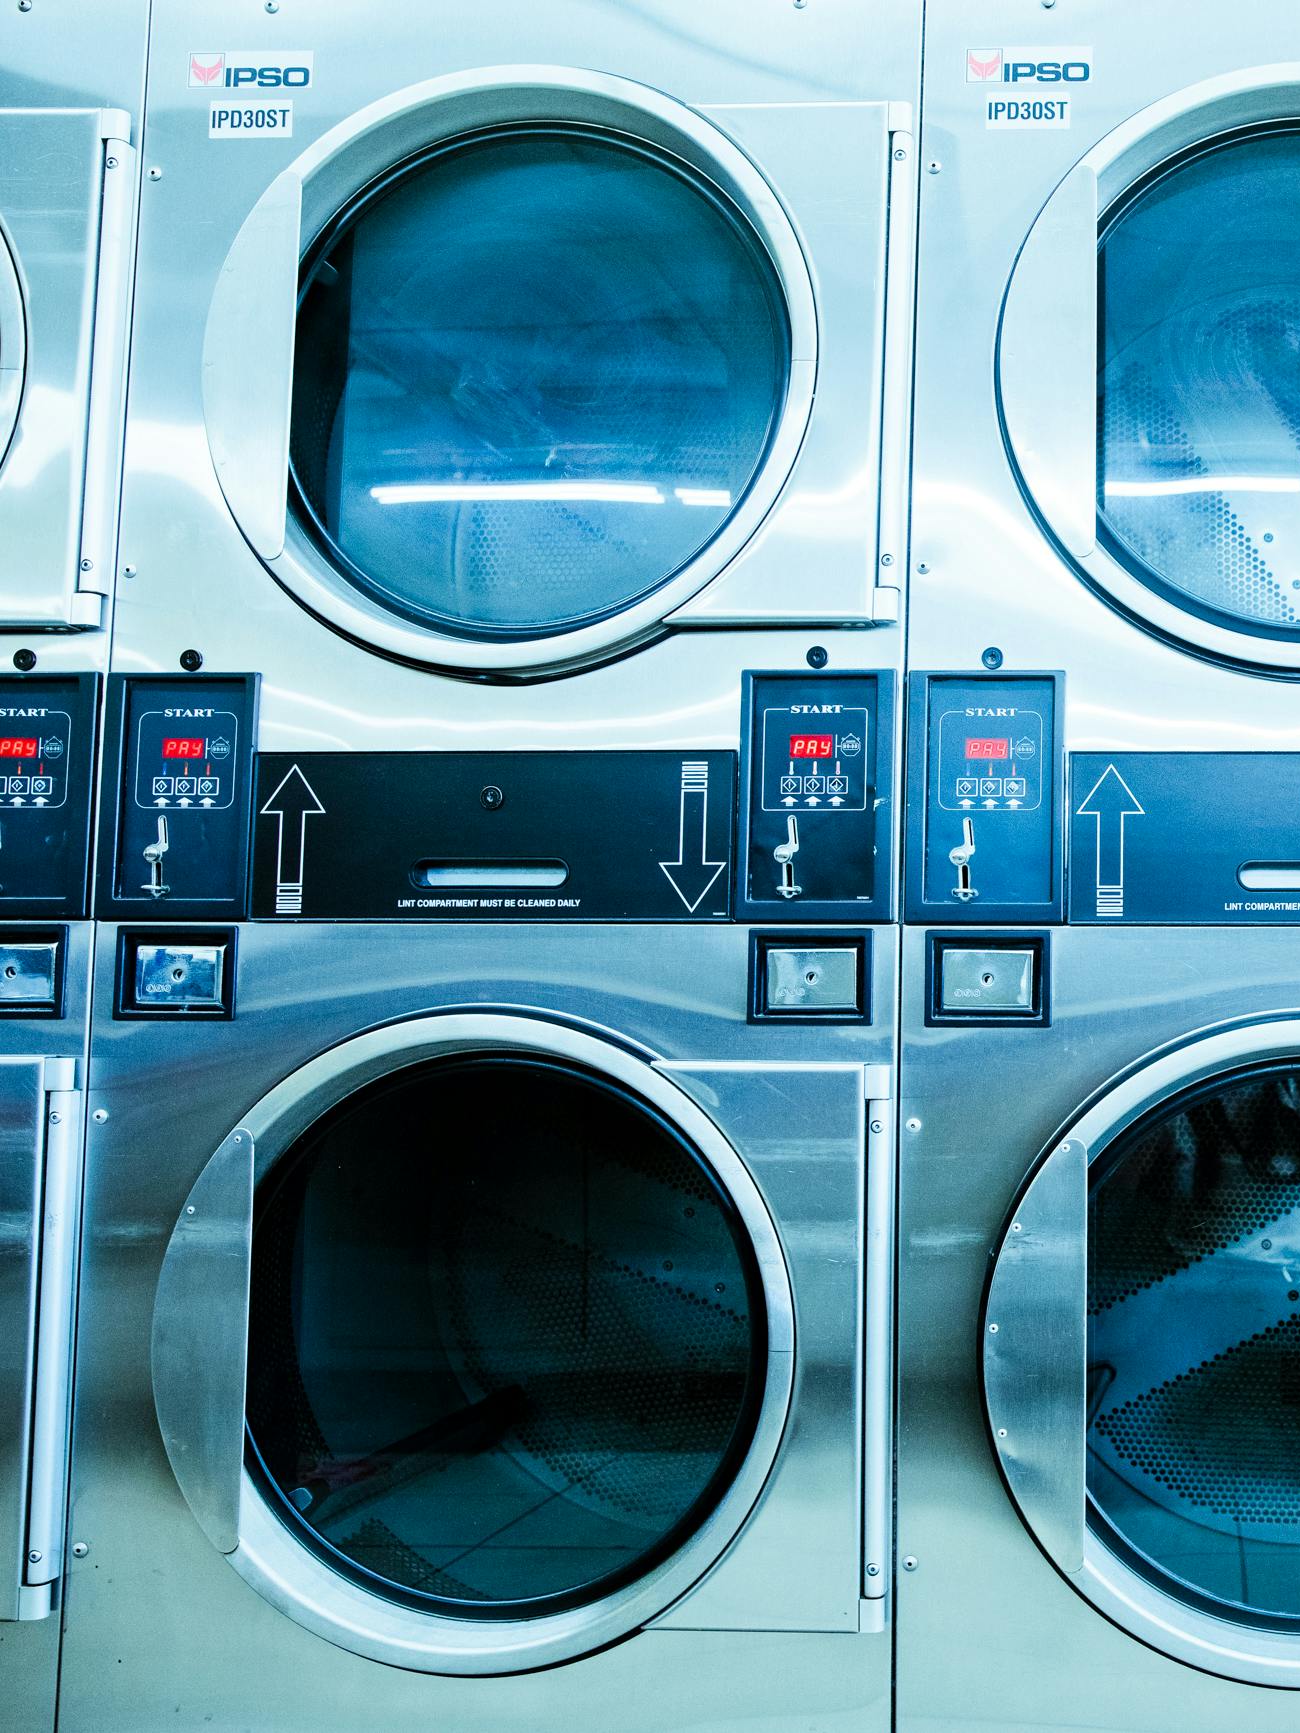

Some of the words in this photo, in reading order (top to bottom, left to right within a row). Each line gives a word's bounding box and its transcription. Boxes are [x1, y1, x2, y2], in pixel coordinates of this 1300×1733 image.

[225, 67, 310, 87] IPSO
[1004, 62, 1090, 82] IPSO
[988, 101, 1068, 120] IPD30ST
[211, 109, 290, 128] IPD30ST
[0, 708, 48, 717] START
[164, 708, 215, 717] START
[790, 705, 843, 714] START
[965, 707, 1018, 717] START
[1, 741, 37, 754] PAY
[165, 741, 203, 754] PAY
[793, 740, 831, 754] PAY
[969, 742, 1008, 756] PAY
[397, 899, 416, 907] LINT
[417, 899, 478, 907] COMPARTMENT
[480, 899, 503, 907] MUST
[504, 899, 516, 907] BE
[517, 899, 556, 907] CLEANED
[557, 899, 581, 907] DAILY
[1224, 902, 1243, 910] LINT
